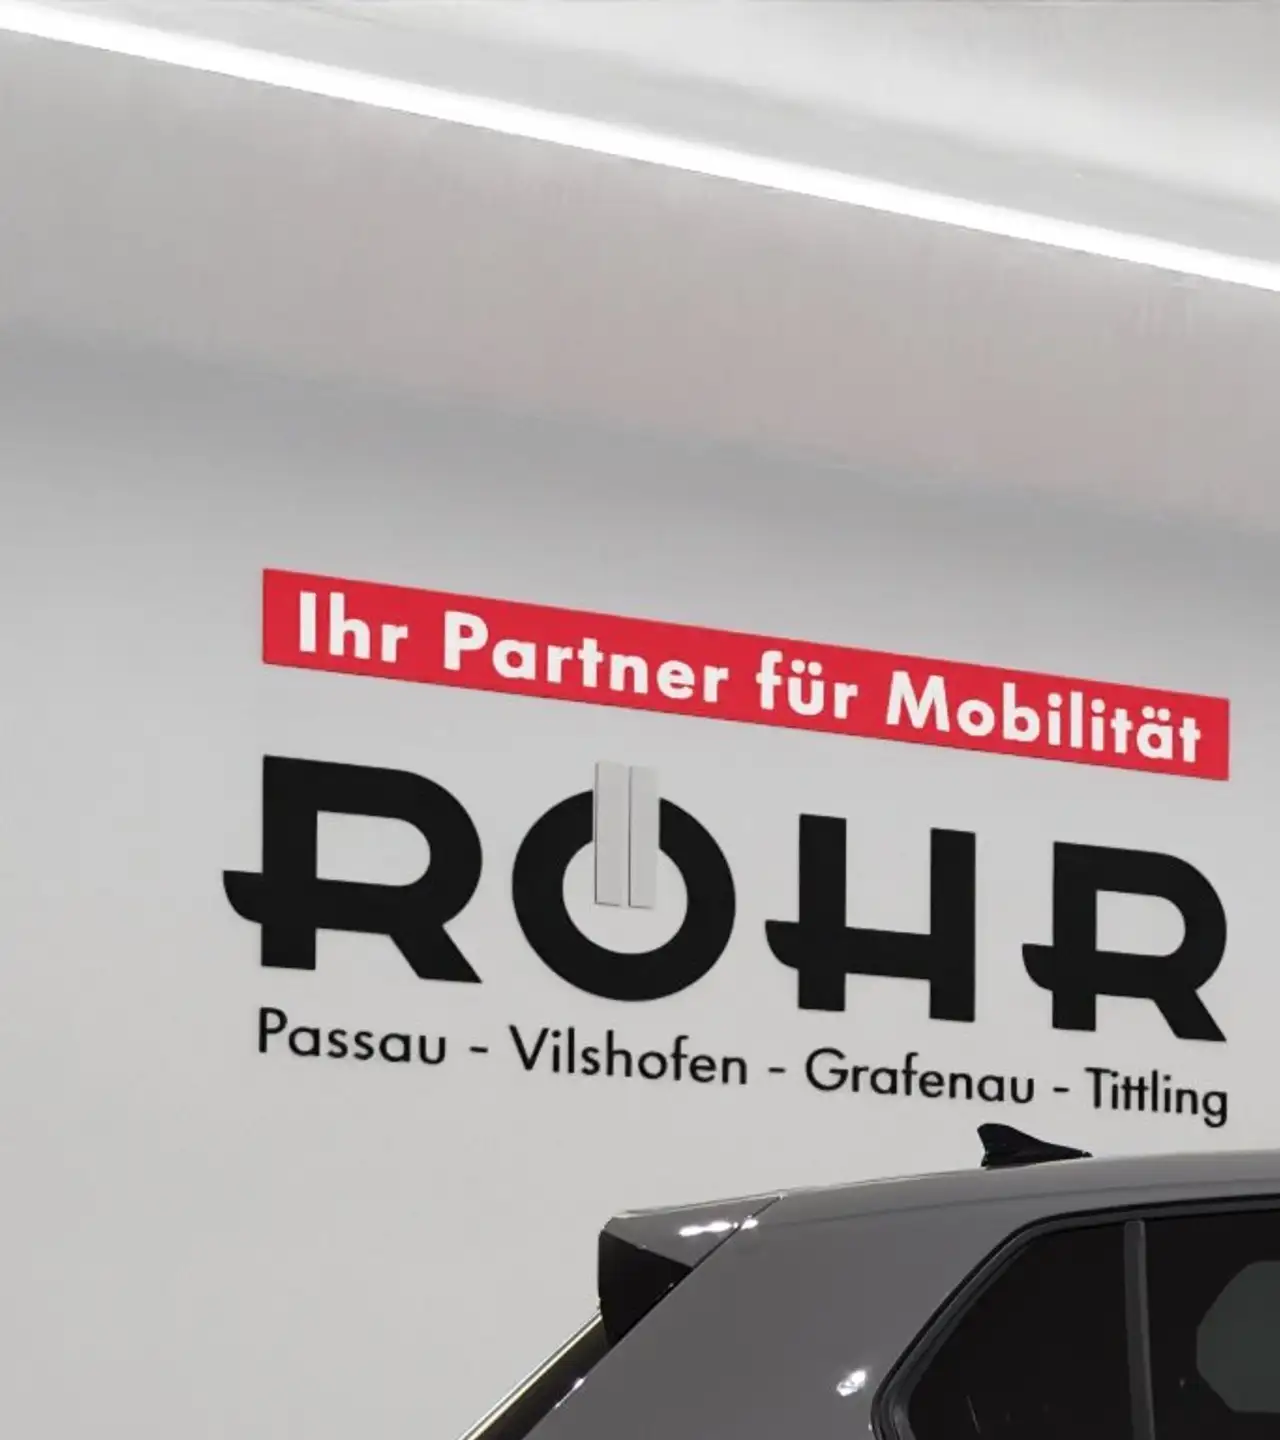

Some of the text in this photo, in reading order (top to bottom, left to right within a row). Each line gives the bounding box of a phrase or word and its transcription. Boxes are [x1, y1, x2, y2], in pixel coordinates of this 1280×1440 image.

[298, 590, 1202, 765] Ihr Partner für Mobilität
[257, 1006, 447, 1066] Passau
[508, 1024, 748, 1085] Vilshofen
[804, 1046, 1036, 1105] Grafenau
[1084, 1066, 1229, 1130] Tittling
